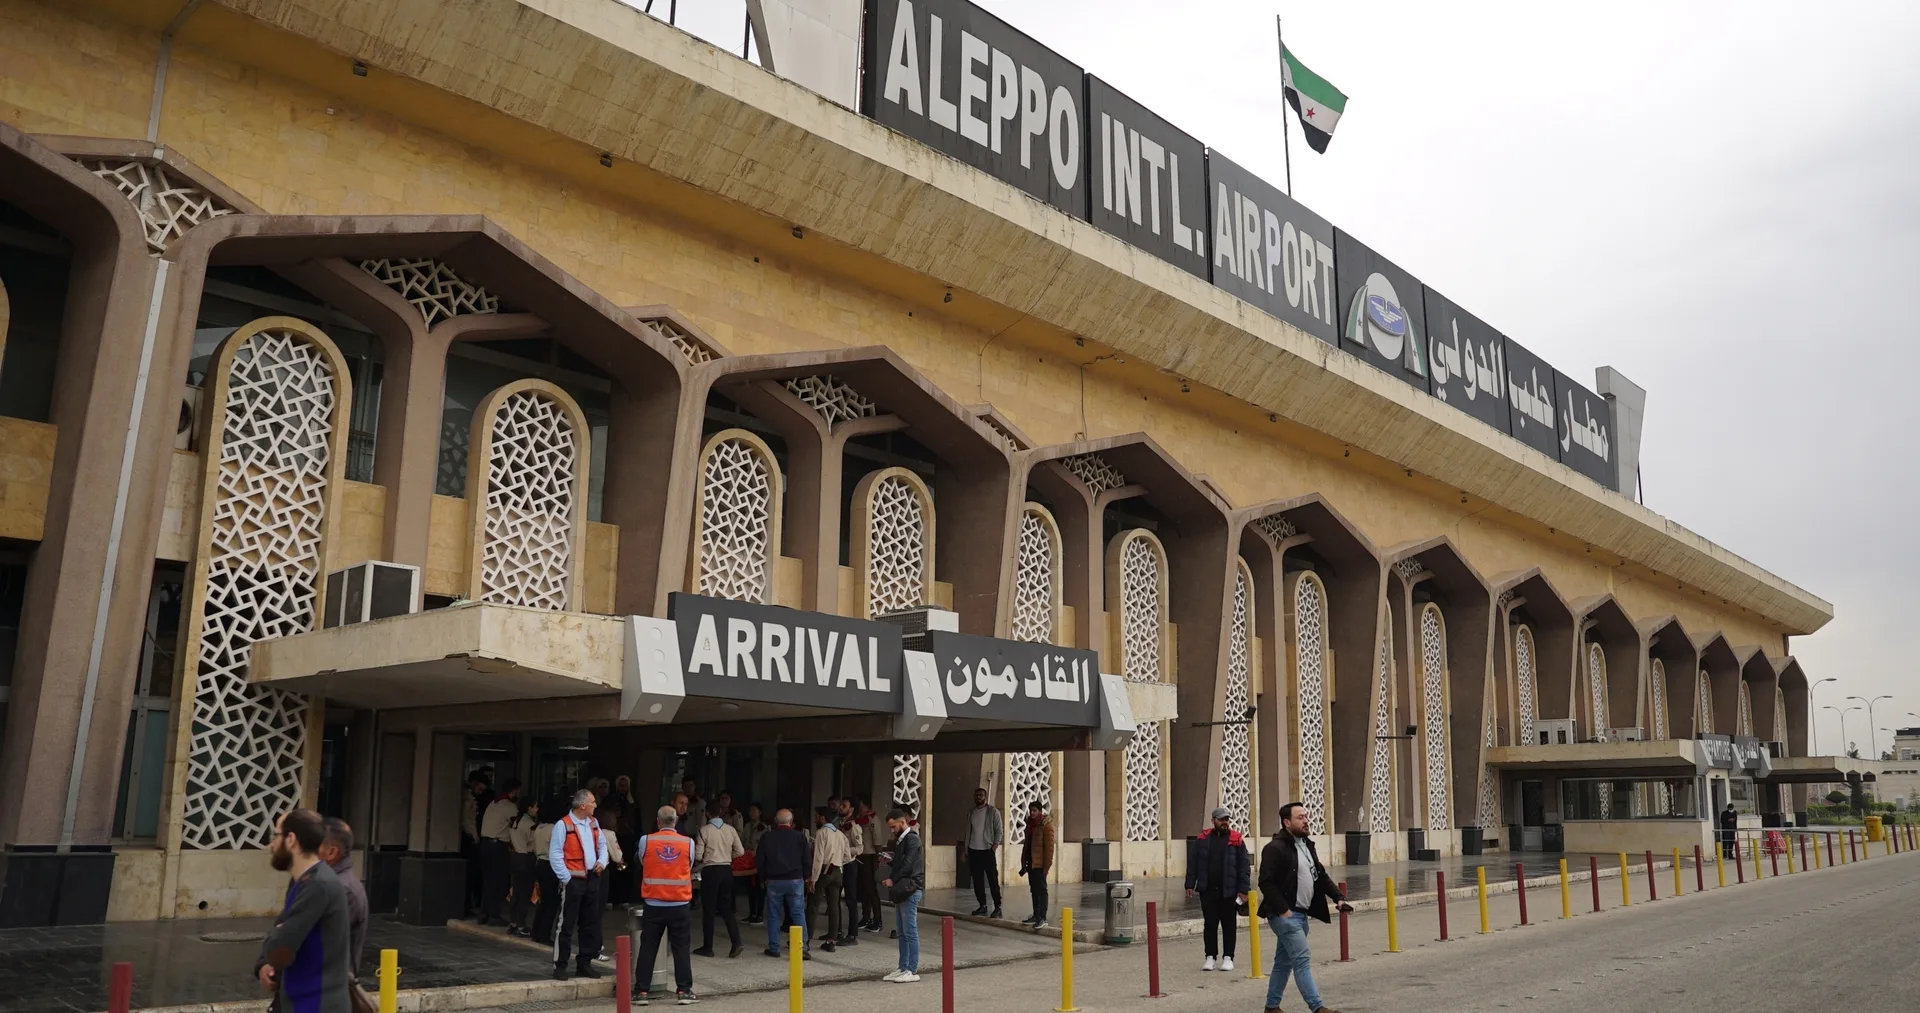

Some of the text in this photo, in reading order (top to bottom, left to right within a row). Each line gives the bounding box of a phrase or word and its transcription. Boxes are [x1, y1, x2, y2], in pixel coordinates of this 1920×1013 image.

[884, 0, 1334, 325] ALEPPO INTL. AIRPORT
[1429, 317, 1609, 463] مطار حلب الدولي
[688, 614, 891, 693] ARRIVAL
[946, 653, 1090, 706] القادمون
